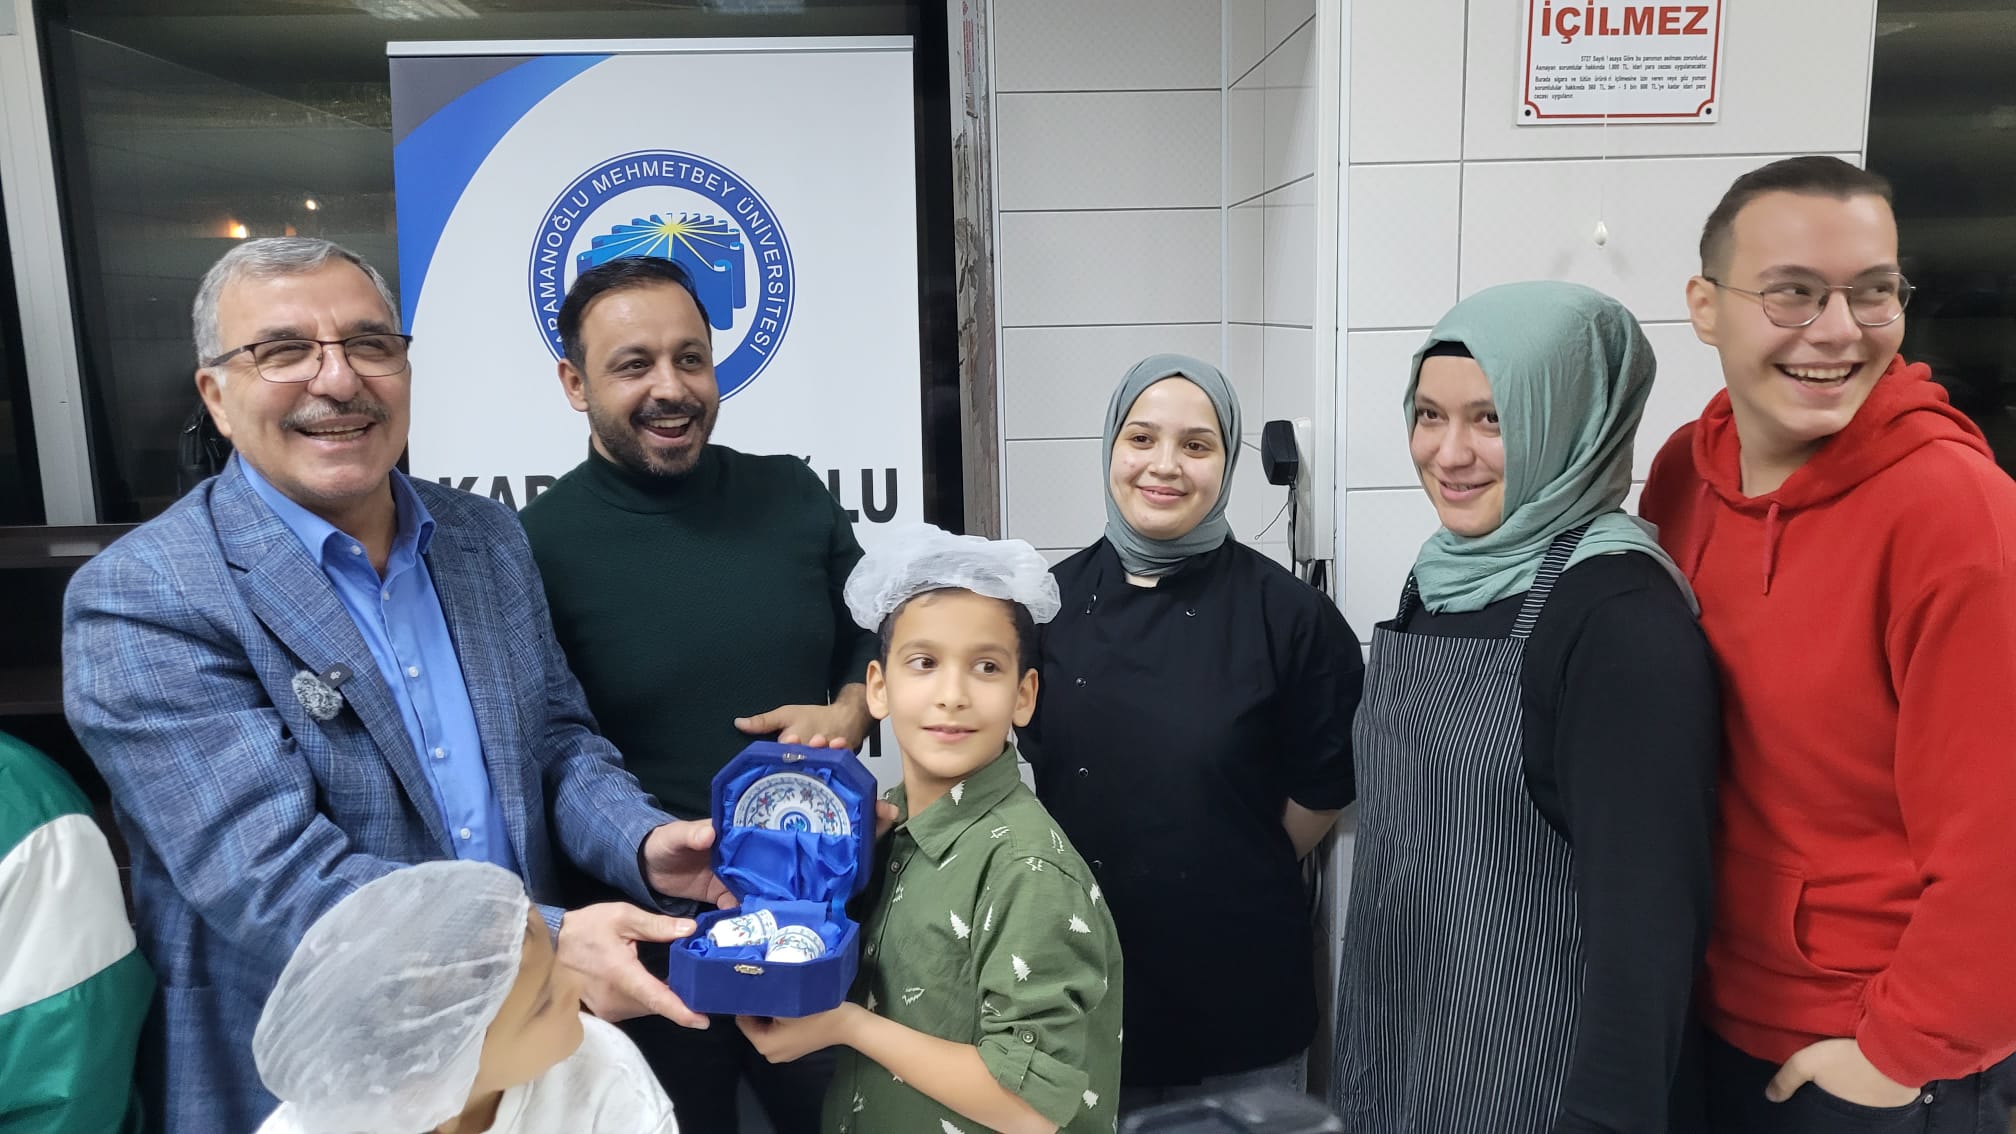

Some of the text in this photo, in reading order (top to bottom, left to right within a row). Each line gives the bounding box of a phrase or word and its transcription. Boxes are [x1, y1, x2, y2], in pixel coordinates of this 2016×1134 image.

[1541, 0, 1709, 44] İÇİLMEZ
[540, 160, 785, 356] RAMANOĞLU MEHMETBEY ÜNİVERSİTESİ
